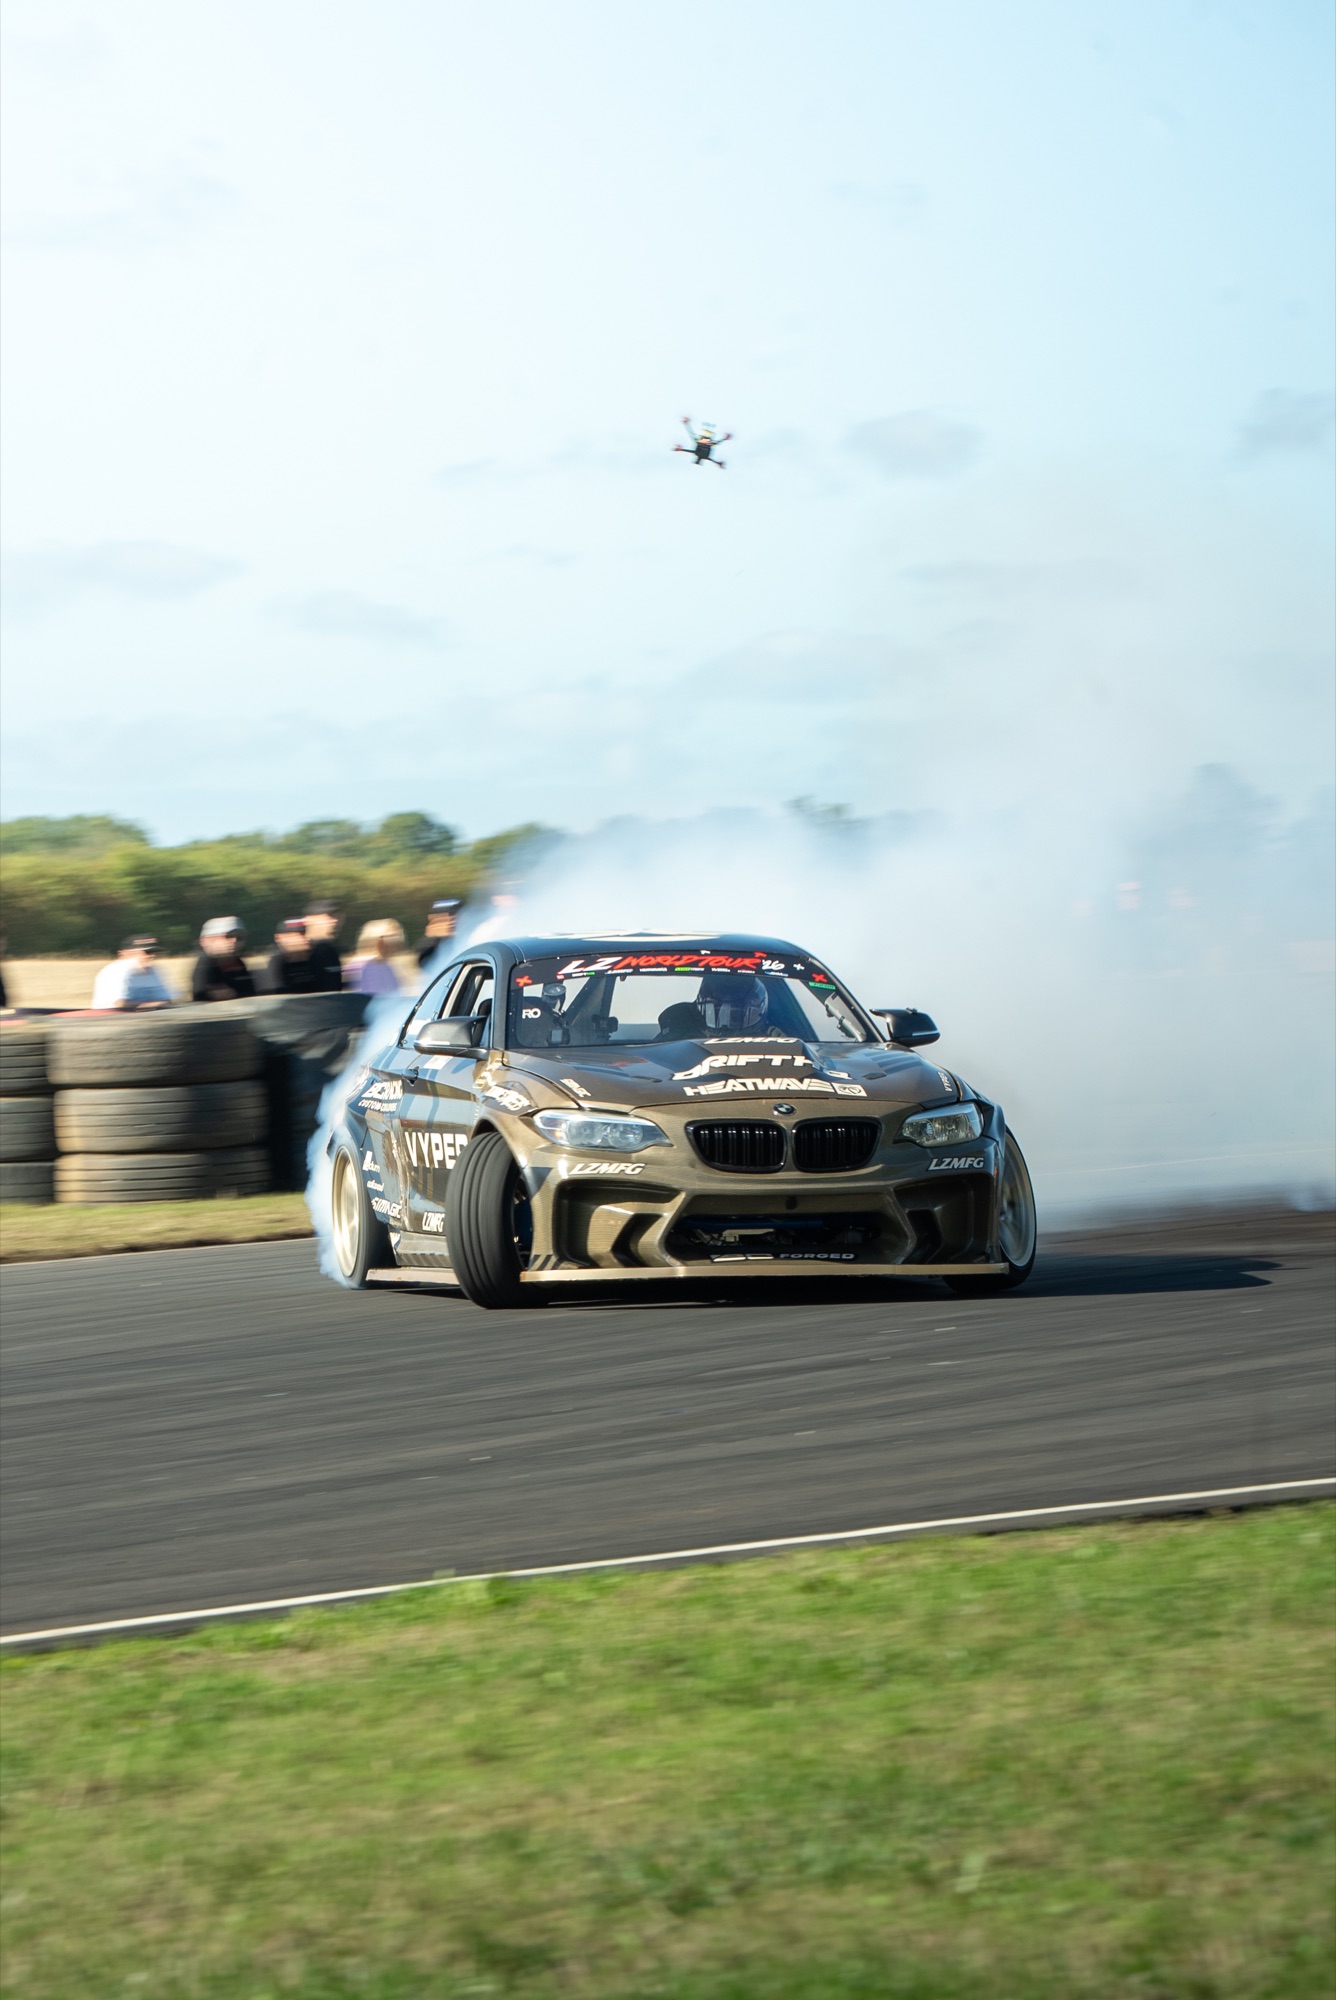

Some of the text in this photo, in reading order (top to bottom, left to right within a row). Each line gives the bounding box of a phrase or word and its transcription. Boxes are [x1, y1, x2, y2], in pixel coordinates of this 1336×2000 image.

[557, 956, 622, 975] LZ
[522, 1008, 542, 1019] RO
[683, 1077, 835, 1097] HEATWAVE
[568, 1162, 646, 1175] LZMFG
[928, 1157, 985, 1171] LZMFG
